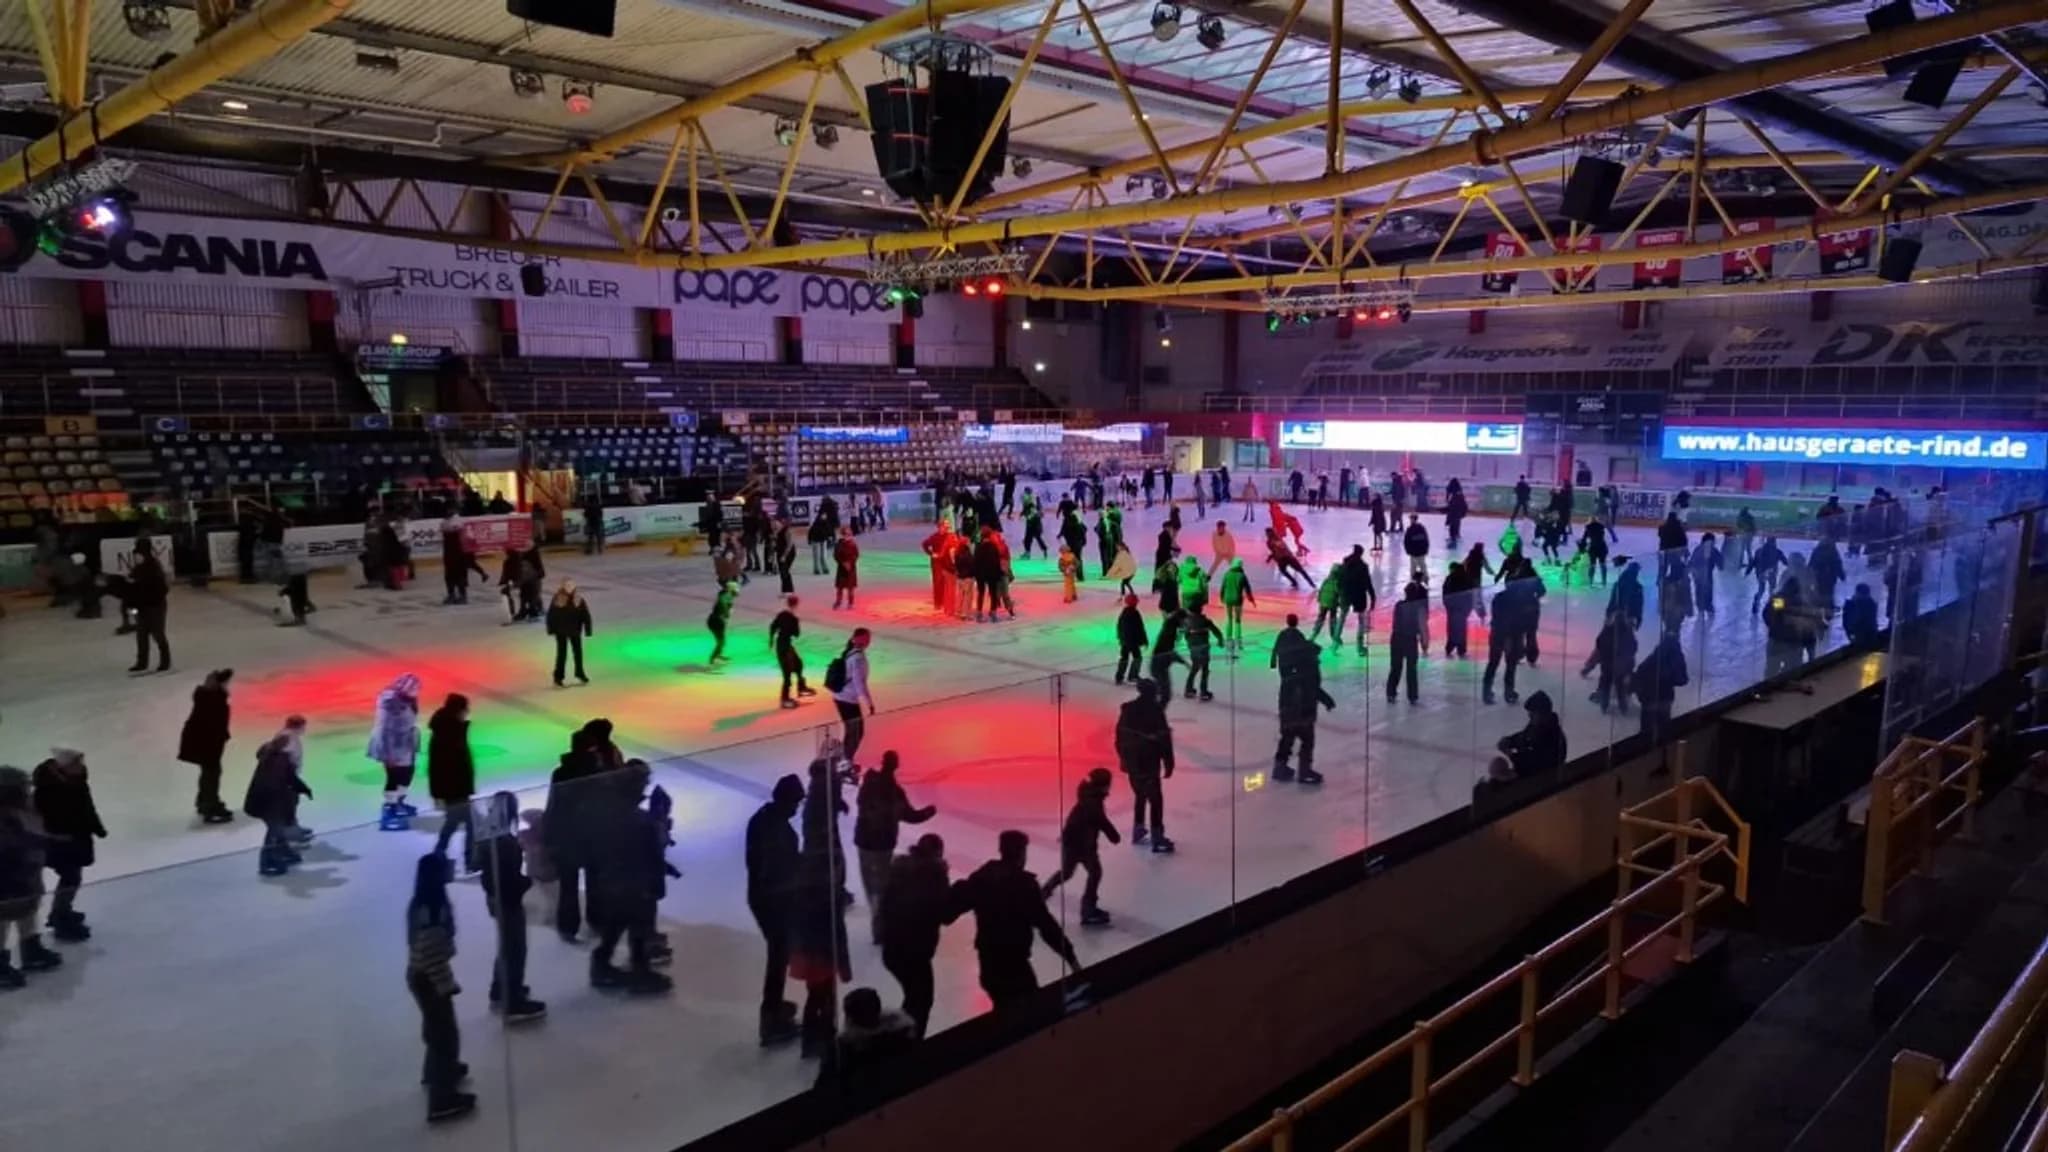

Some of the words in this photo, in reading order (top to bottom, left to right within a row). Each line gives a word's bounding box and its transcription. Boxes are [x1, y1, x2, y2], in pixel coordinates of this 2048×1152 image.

[56, 229, 328, 281] SCANIA
[388, 266, 490, 289] TRUCK
[496, 272, 514, 292] &
[542, 276, 621, 299] RAILER
[674, 267, 780, 309] pape
[801, 274, 895, 316] pape
[62, 419, 81, 432] B
[157, 417, 177, 432] C
[1678, 432, 2029, 460] www.hausgeraete-rind.de
